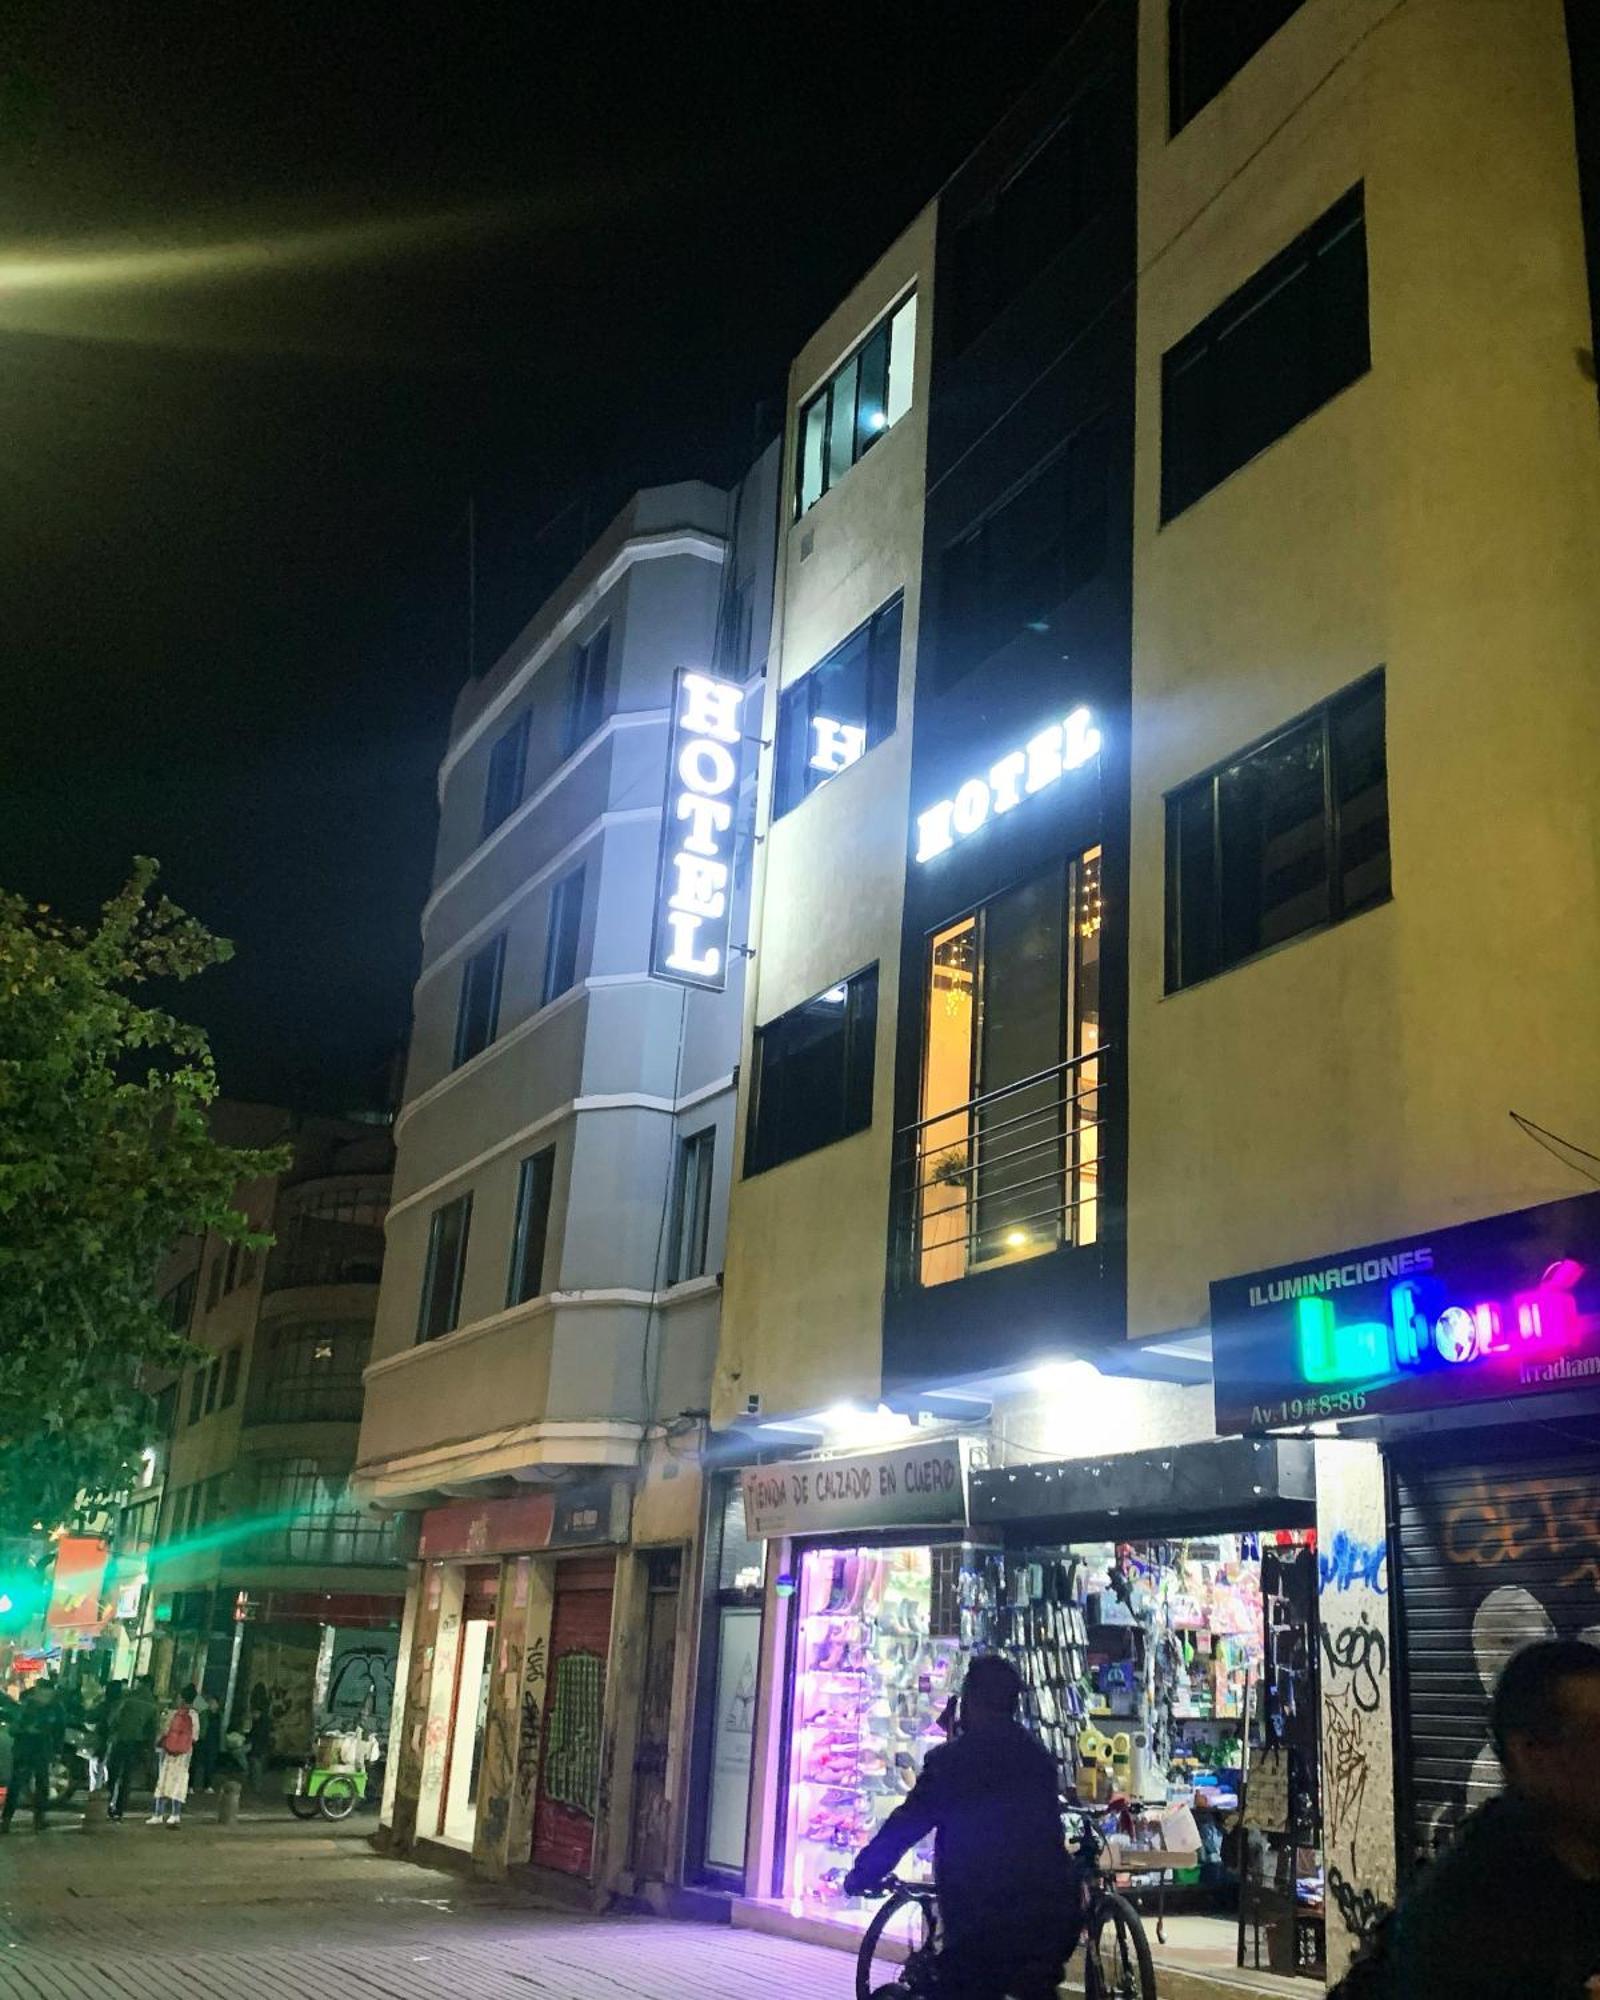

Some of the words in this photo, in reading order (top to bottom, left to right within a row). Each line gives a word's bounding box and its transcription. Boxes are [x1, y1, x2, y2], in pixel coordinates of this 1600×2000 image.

[667, 675, 743, 976] HOTEL
[915, 705, 1102, 864] HOTEL
[1249, 1247, 1434, 1307] ILUMINACIONES
[792, 1474, 809, 1505] DE
[816, 1466, 872, 1501] CALZADO
[879, 1465, 897, 1496] EN
[904, 1458, 955, 1494] CUERO
